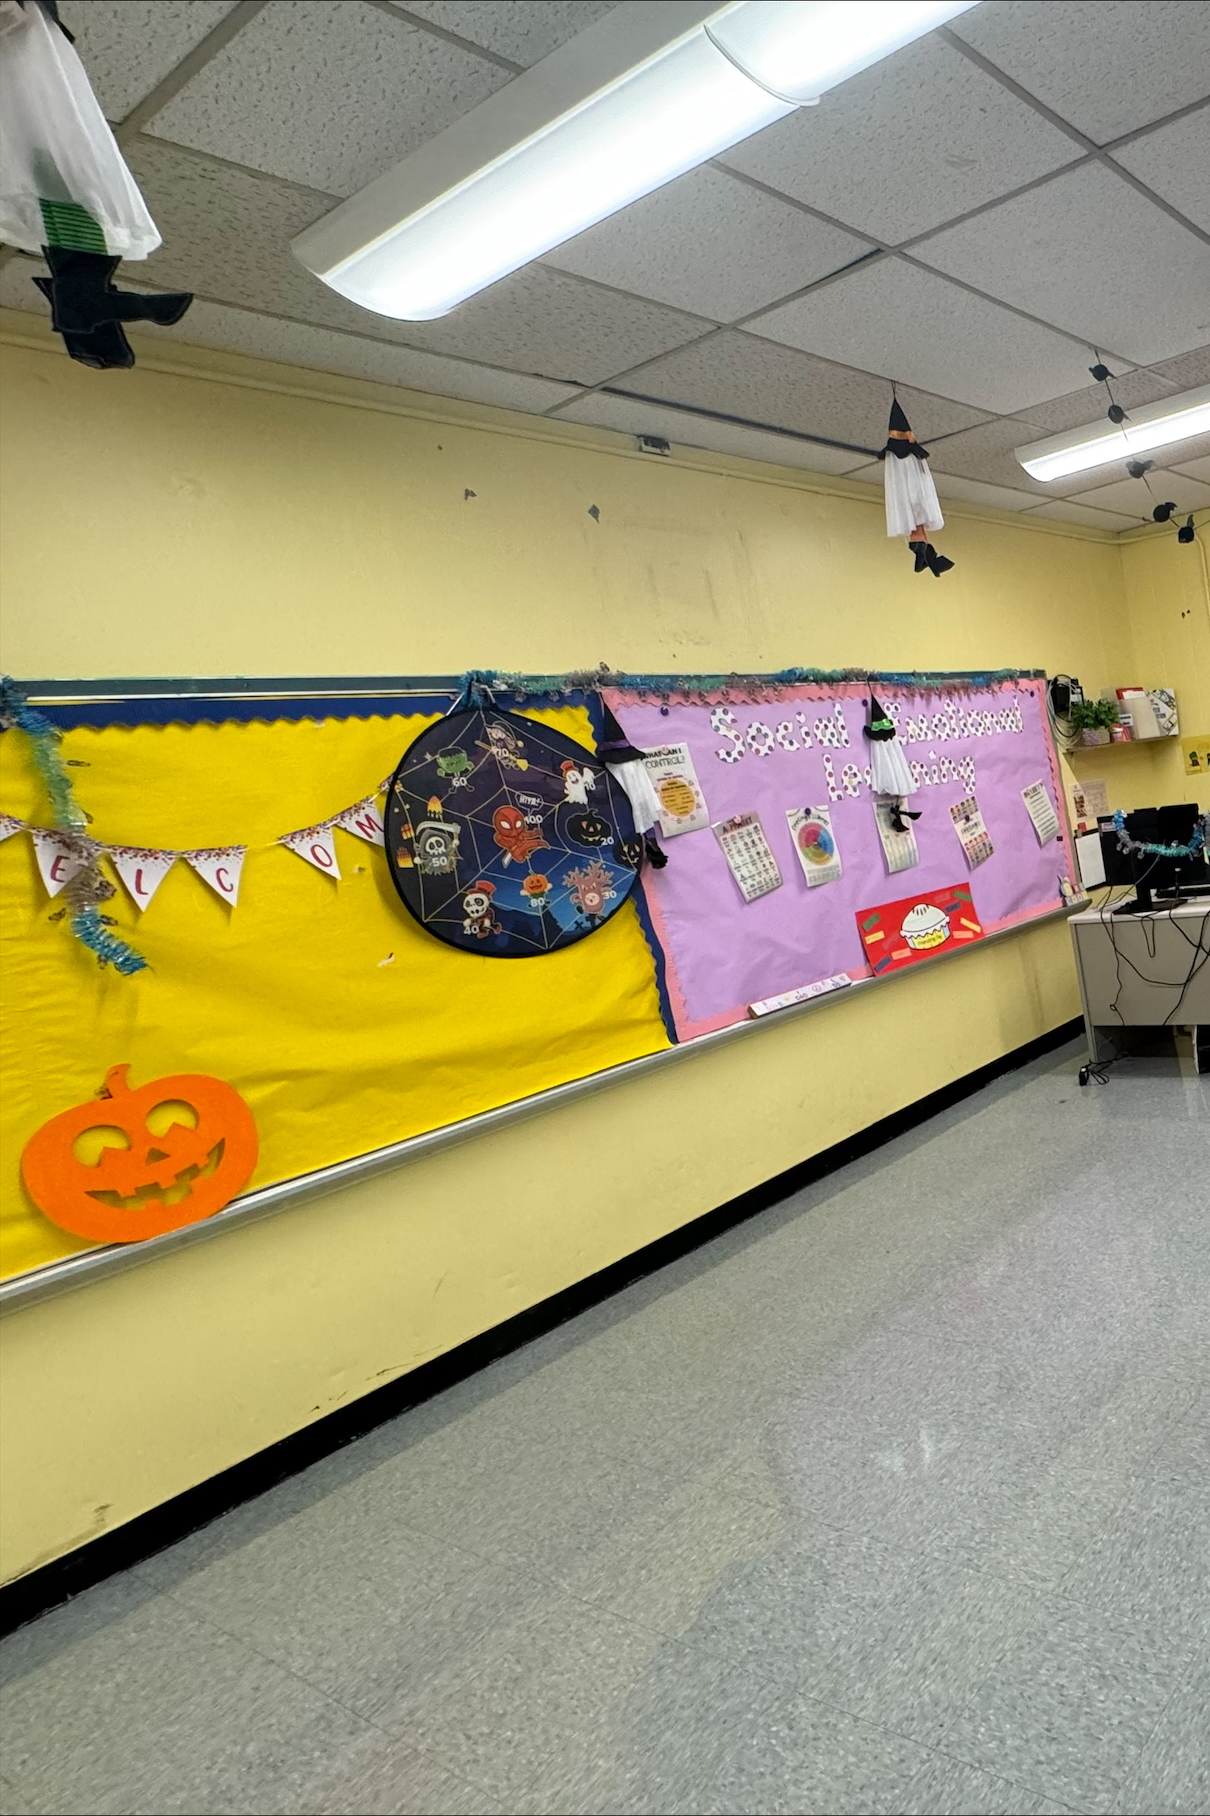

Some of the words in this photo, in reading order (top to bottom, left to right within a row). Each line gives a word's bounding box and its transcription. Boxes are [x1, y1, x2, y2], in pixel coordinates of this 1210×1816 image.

[710, 702, 851, 763] Social
[645, 755, 685, 769] CONTROL?
[822, 750, 976, 801] Lening
[452, 777, 468, 787] 60
[524, 814, 543, 824] 100
[601, 836, 615, 846] 20
[432, 857, 448, 867] 50
[603, 891, 617, 900] 30
[531, 898, 545, 907] 80
[463, 925, 480, 935] 40
